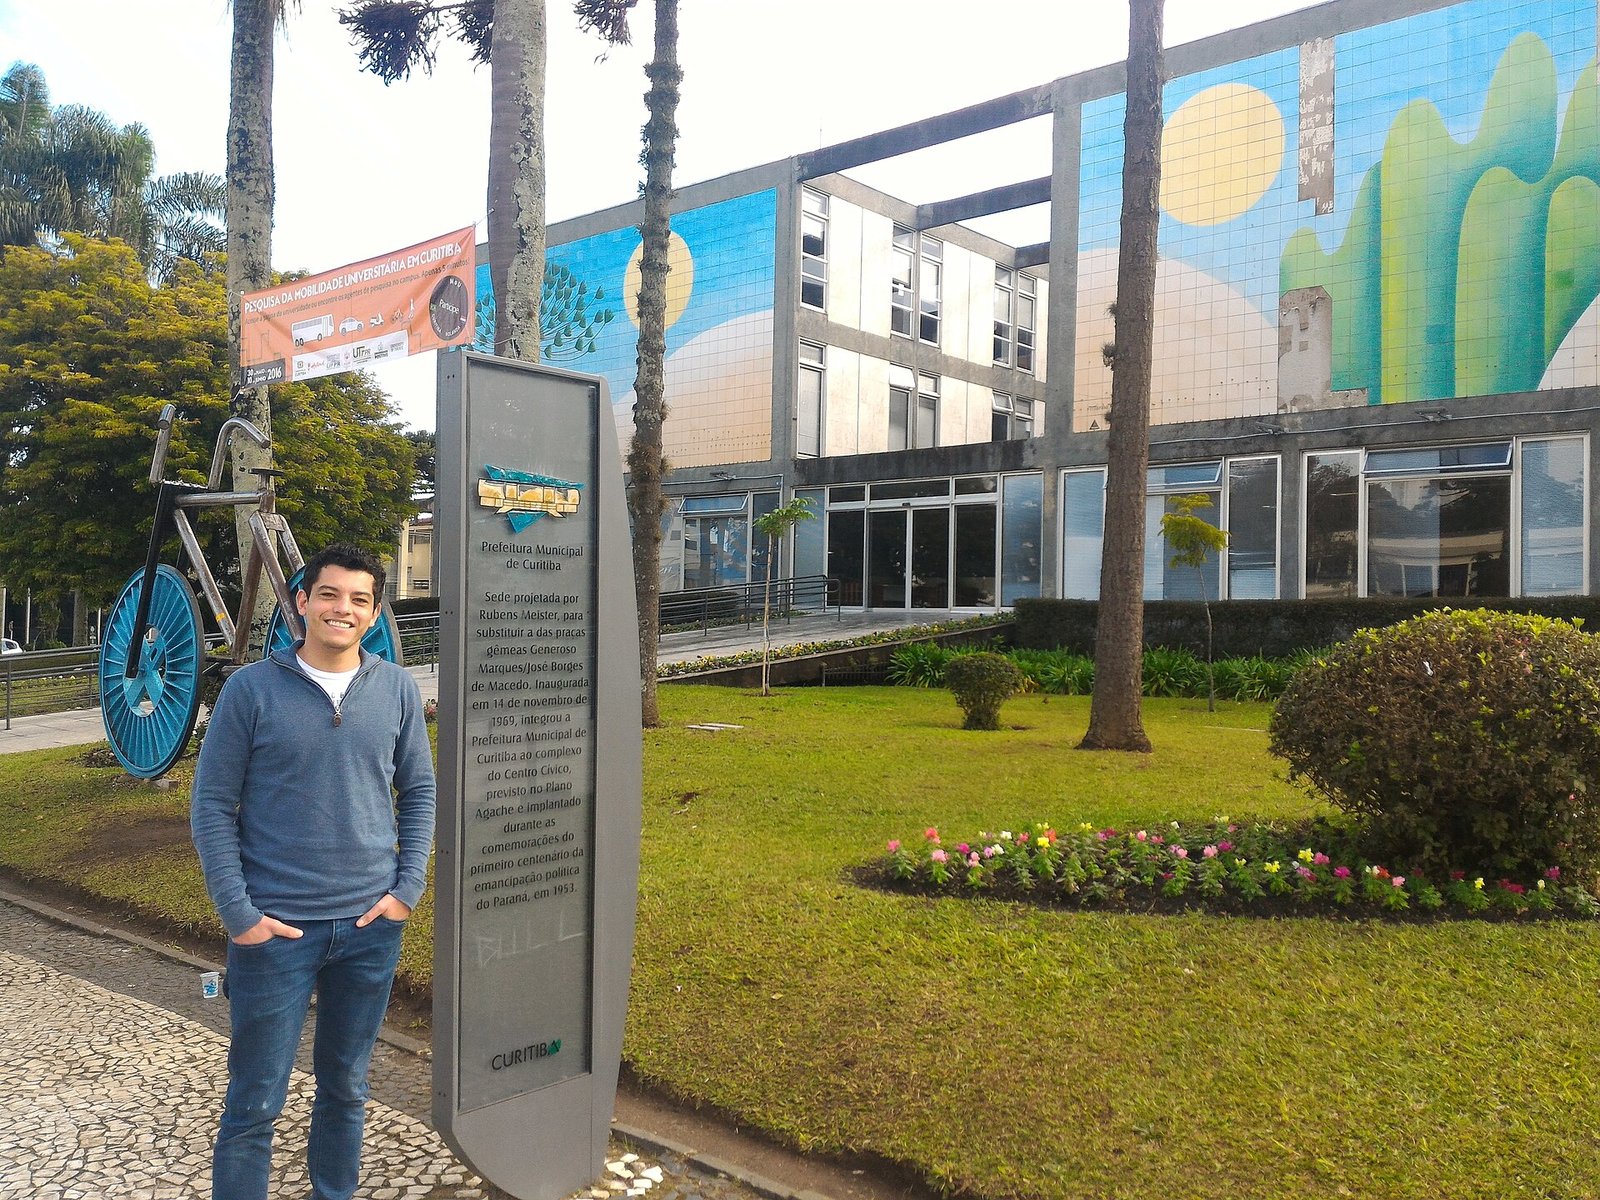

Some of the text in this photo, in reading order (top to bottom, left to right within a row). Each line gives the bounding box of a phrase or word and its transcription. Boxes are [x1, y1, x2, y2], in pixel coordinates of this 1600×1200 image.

[244, 242, 462, 314] PESQUISA DA MOBILIDADE UNIVERSITÁRIA EM CURITIBA
[267, 366, 282, 380] 2016
[482, 541, 583, 558] Prefeitura Municipal
[506, 558, 561, 571] de Curitiba
[485, 591, 579, 605] Sede projetada por
[479, 609, 583, 622] Rubens Meister, para
[476, 627, 586, 639] substituir a das praças
[486, 644, 577, 658] gêmeas Generoso
[479, 661, 583, 675] Marques/José Borges
[471, 677, 589, 692] de Macedo. Inaugurada
[472, 694, 587, 710] em 14 de novembro de
[491, 713, 571, 727] 1969, integrou a
[472, 728, 587, 747] Prefeitura Municipal de
[477, 746, 582, 764] Curitiba ao complexo
[488, 764, 572, 782] do Centro Cívico,
[486, 781, 572, 801] previsto no Plano
[475, 796, 581, 820] Agache e implantado
[503, 818, 556, 833] durante as
[481, 831, 574, 855] comemorações do
[470, 847, 584, 876] primeiro centenário da
[474, 866, 580, 893] emancipação política
[476, 883, 577, 910] do Paraná, em 1953.
[491, 1040, 560, 1070] CURITIBA
